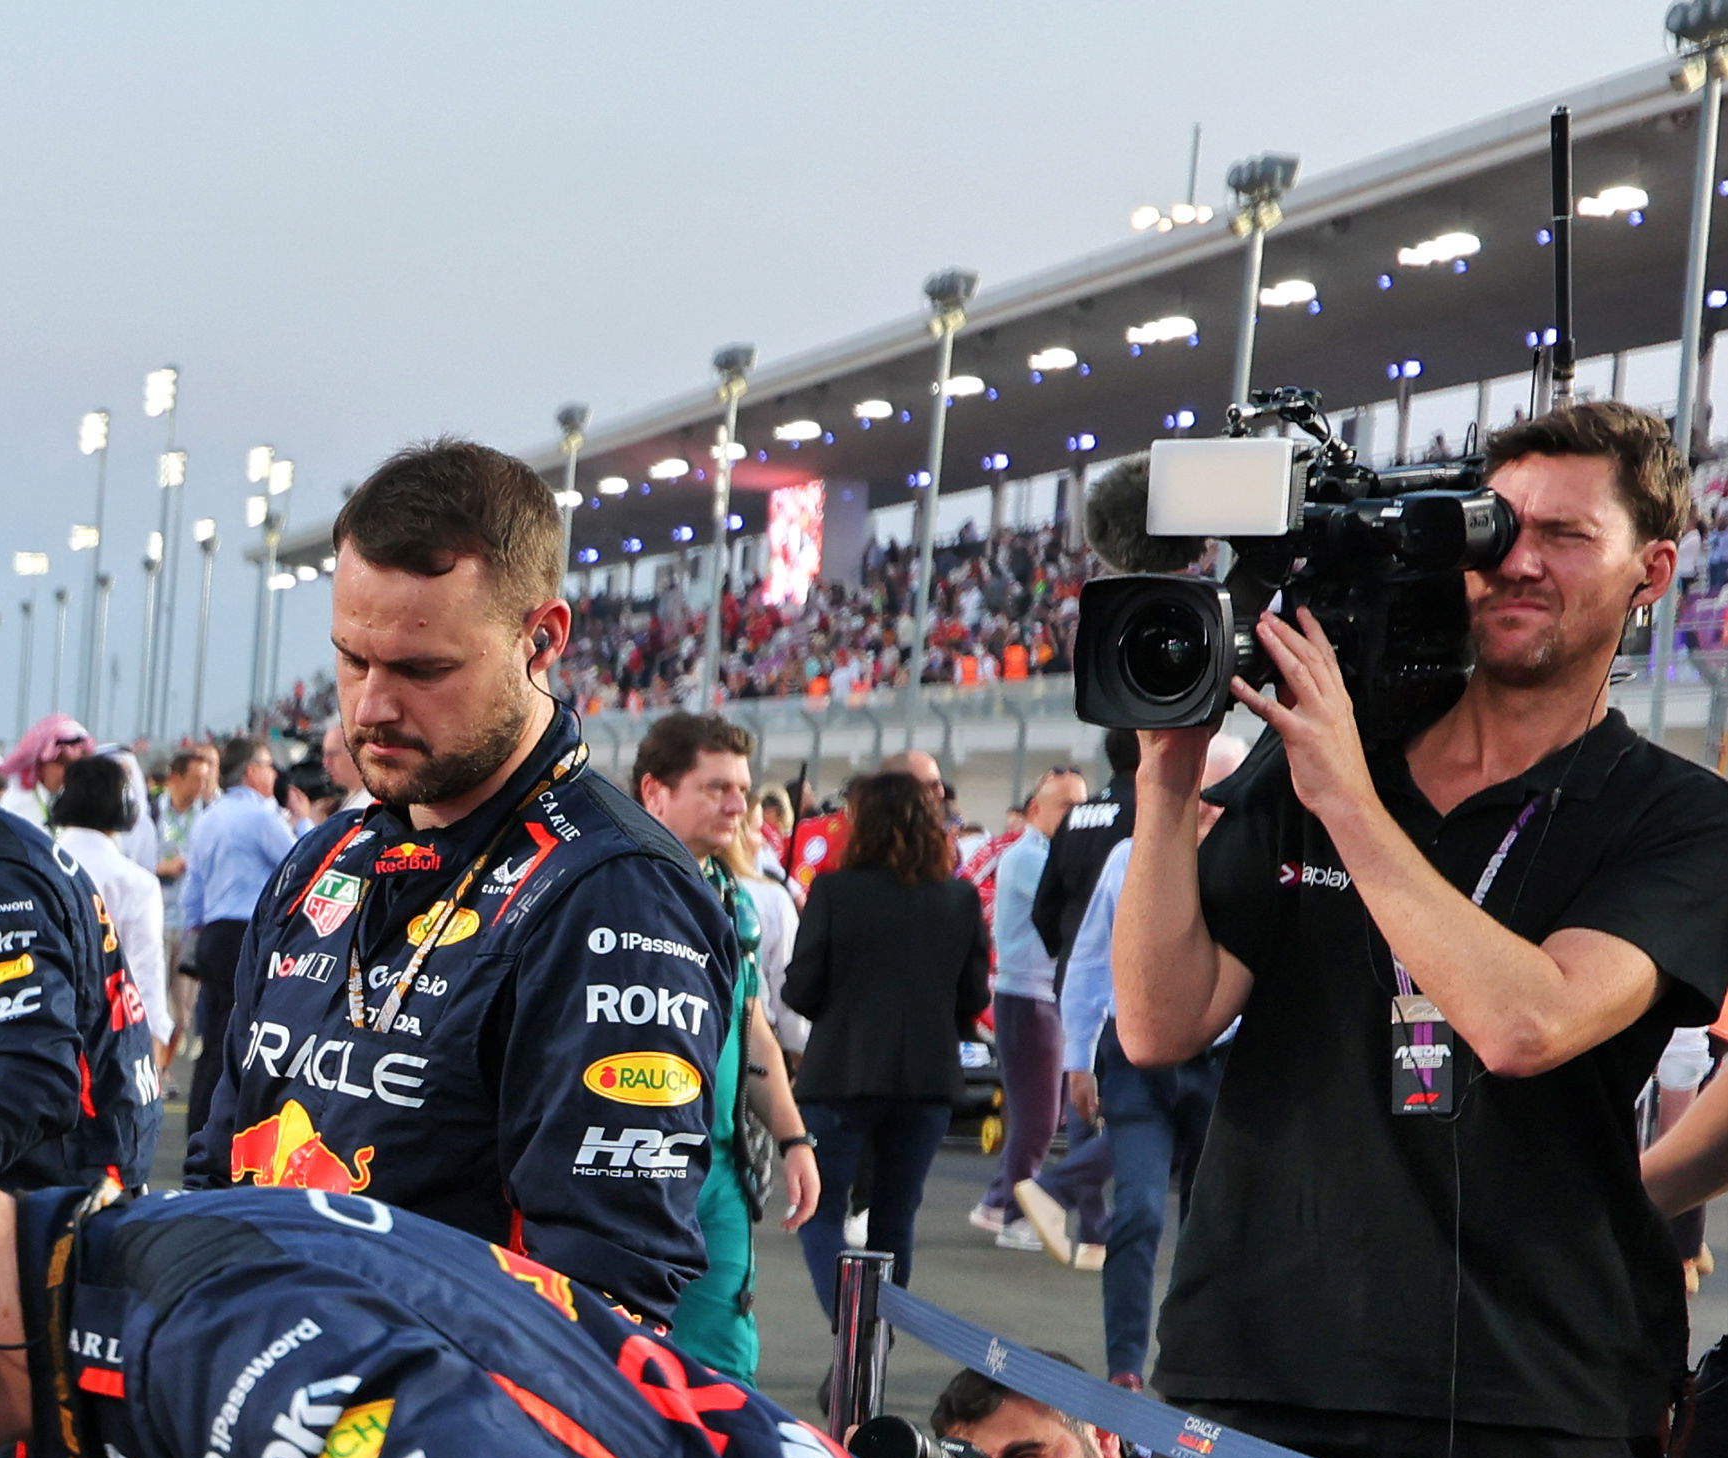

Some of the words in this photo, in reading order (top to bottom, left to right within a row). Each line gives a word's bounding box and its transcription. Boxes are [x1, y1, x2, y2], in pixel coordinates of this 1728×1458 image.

[620, 930, 710, 970] 1Password
[586, 984, 709, 1037] ROKT
[620, 1066, 691, 1092] RAUCH
[574, 1126, 706, 1169] HRC
[572, 1165, 635, 1178] Honda
[638, 1166, 687, 1180] RACING
[210, 1317, 324, 1454] 1Password
